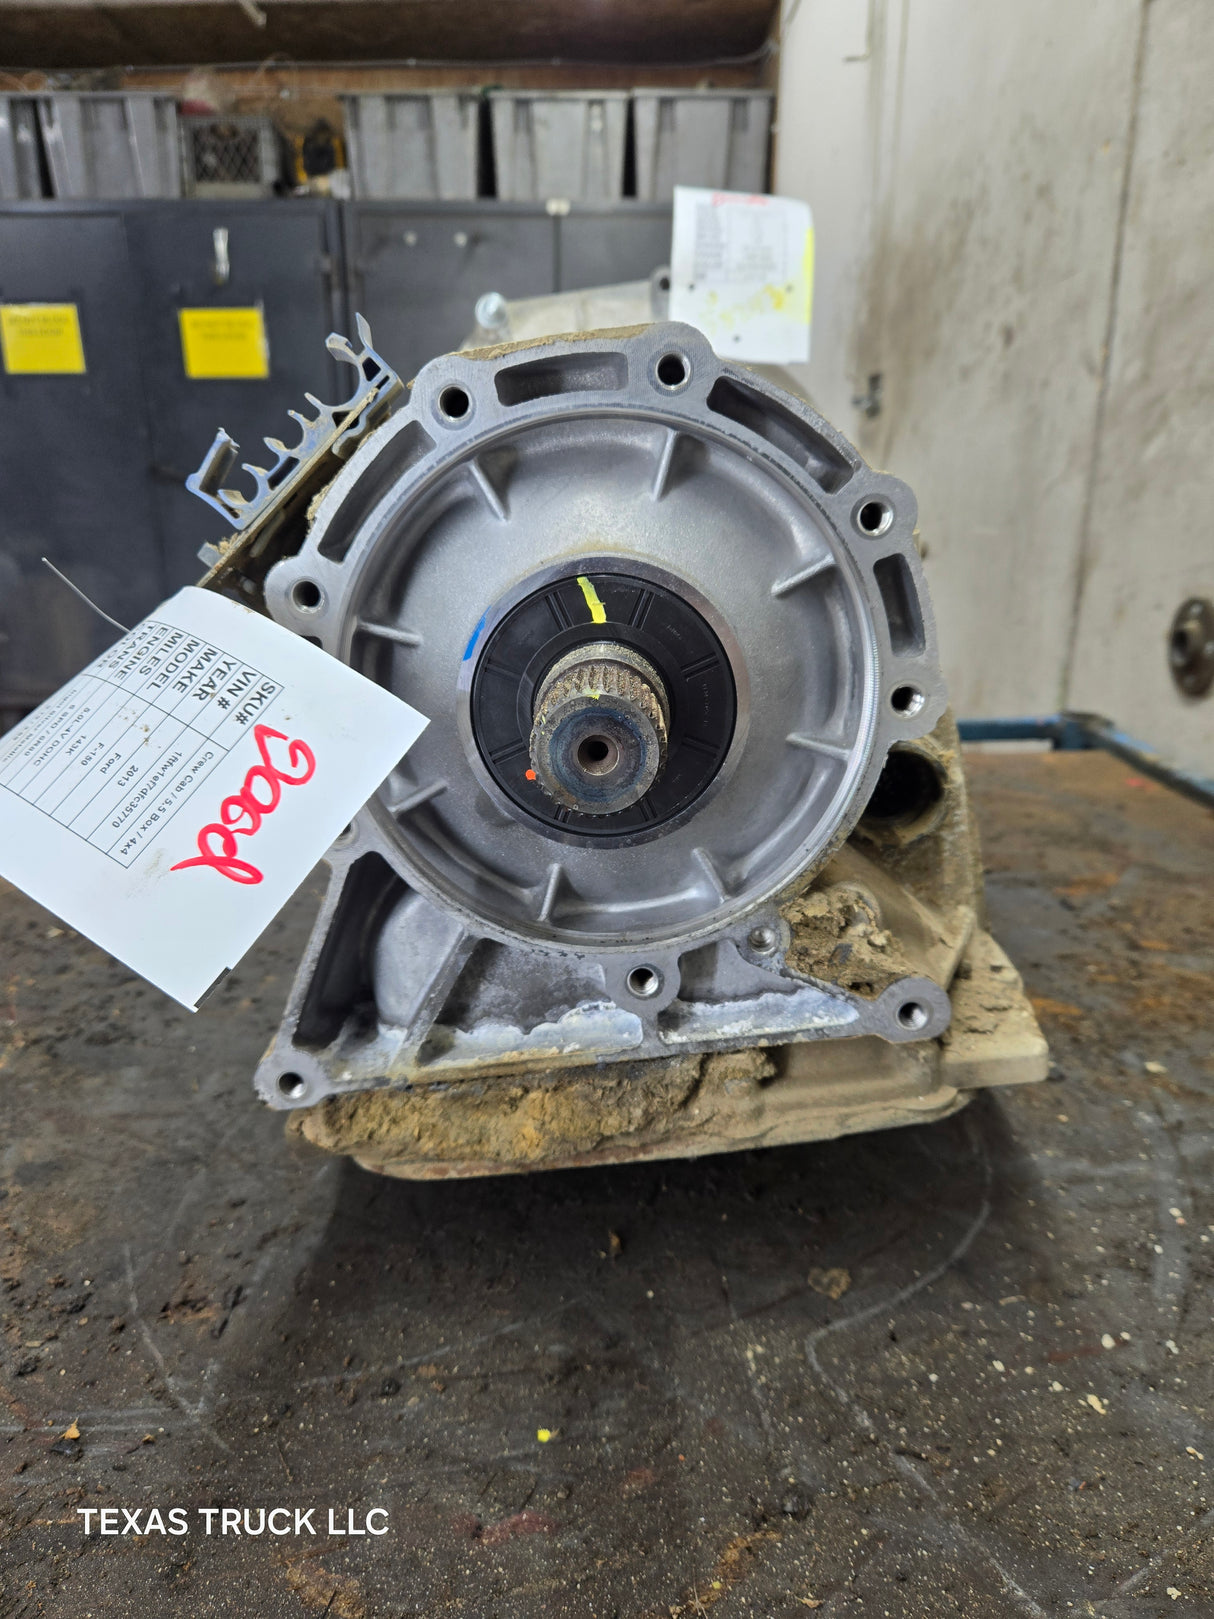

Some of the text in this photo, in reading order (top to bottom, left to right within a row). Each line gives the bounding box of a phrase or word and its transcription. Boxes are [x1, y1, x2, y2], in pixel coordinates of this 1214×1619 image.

[108, 625, 155, 668] TRANS
[115, 627, 169, 680] ENGINE
[139, 632, 184, 676] MILES
[146, 639, 200, 690] MODEL
[172, 648, 218, 693] MAKE
[192, 660, 237, 701] YEAR
[217, 671, 257, 710] VIN #
[235, 682, 275, 725] SKU#
[33, 740, 60, 766] DOHC
[65, 735, 86, 755] 143K
[80, 742, 105, 766] F-150
[99, 752, 122, 774] Ford
[191, 751, 214, 774] Crew
[117, 765, 139, 787] 2013
[175, 775, 193, 793] Cab
[157, 798, 173, 813] 5.5
[140, 812, 160, 832] Box
[120, 837, 137, 855] 4x4
